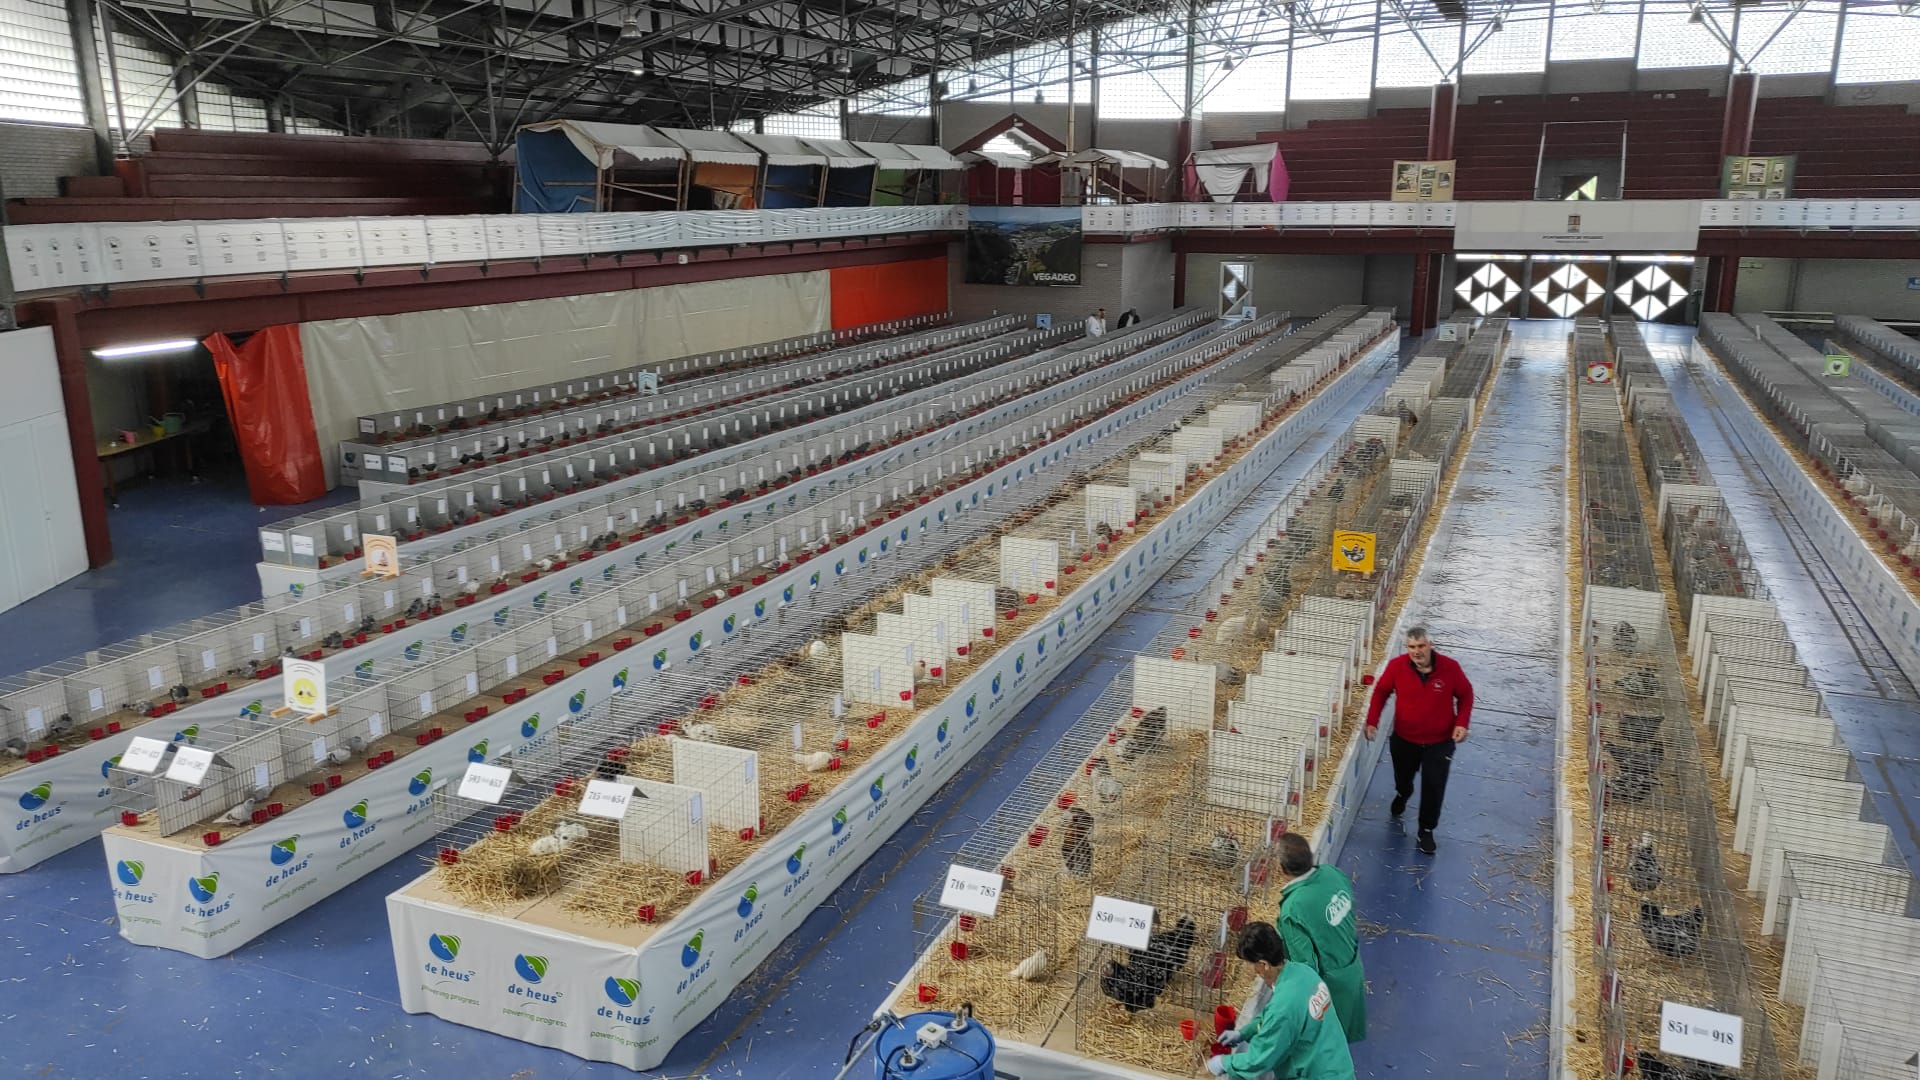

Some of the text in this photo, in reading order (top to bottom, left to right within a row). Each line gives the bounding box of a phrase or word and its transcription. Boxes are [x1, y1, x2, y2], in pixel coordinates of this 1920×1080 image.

[1032, 272, 1077, 281] VEGADEO
[16, 806, 62, 831] de heus
[340, 823, 377, 848] de heus
[266, 859, 308, 887] de heus
[125, 890, 154, 904] heus
[950, 878, 997, 898] 716 785
[185, 901, 231, 918] de heus
[1096, 911, 1146, 930] 850 786
[425, 963, 470, 982] de heus
[677, 960, 711, 994] de heus
[508, 984, 557, 1004] de heus
[597, 1006, 650, 1026] de heus
[590, 1030, 660, 1049] powering progress
[1667, 1020, 1734, 1045] 851 918
